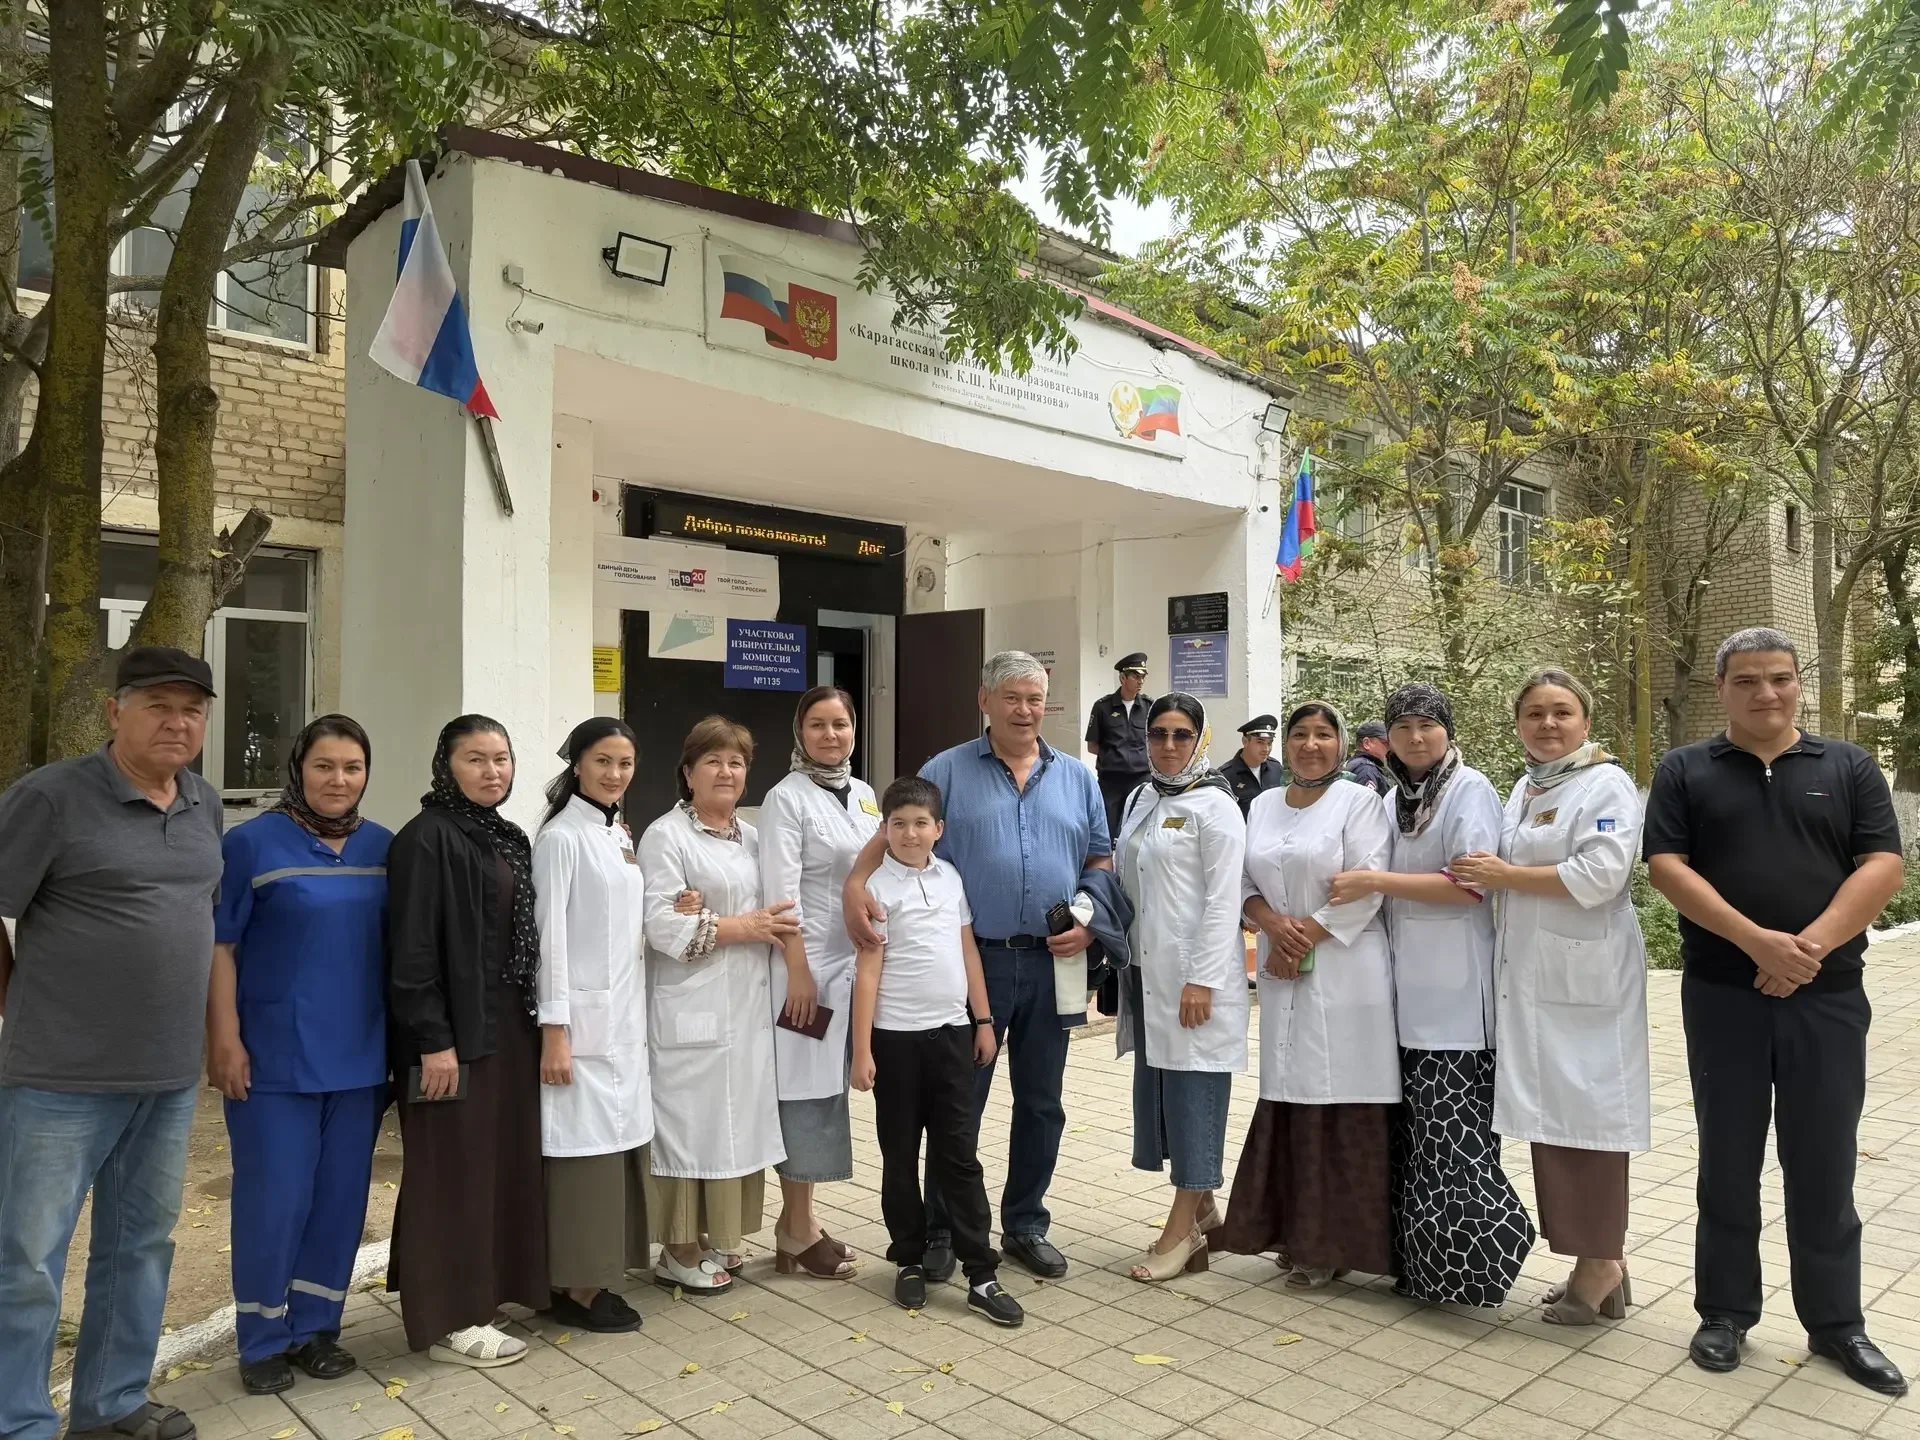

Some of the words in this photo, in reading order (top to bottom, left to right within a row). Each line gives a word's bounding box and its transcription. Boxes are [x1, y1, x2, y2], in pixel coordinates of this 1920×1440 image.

[849, 323, 935, 358] «Карагасская
[890, 355, 930, 374] школа
[933, 366, 953, 380] им.
[957, 369, 986, 389] К.Ш.
[989, 378, 1070, 409] Кидирниязова»
[684, 514, 732, 534] Добро
[735, 524, 827, 547] пожаловать!
[597, 563, 623, 571] ЕДИНЫЙ
[614, 571, 657, 581] ГОЛОСОВАНИЯ
[670, 578, 680, 587] 18
[680, 575, 691, 584] 19
[691, 572, 704, 582] 20
[731, 578, 748, 586] ГОЛОС
[738, 628, 794, 640] УЧАСТКОВАЯ
[731, 640, 801, 652] ИЗБИРАТЕЛЬНАЯ
[742, 652, 791, 663] КОМИССИЯ
[732, 664, 778, 673] ИЗБИРАТЕЛЬНОГО
[778, 666, 800, 674] УЧАСТКА
[753, 676, 781, 686] №1135
